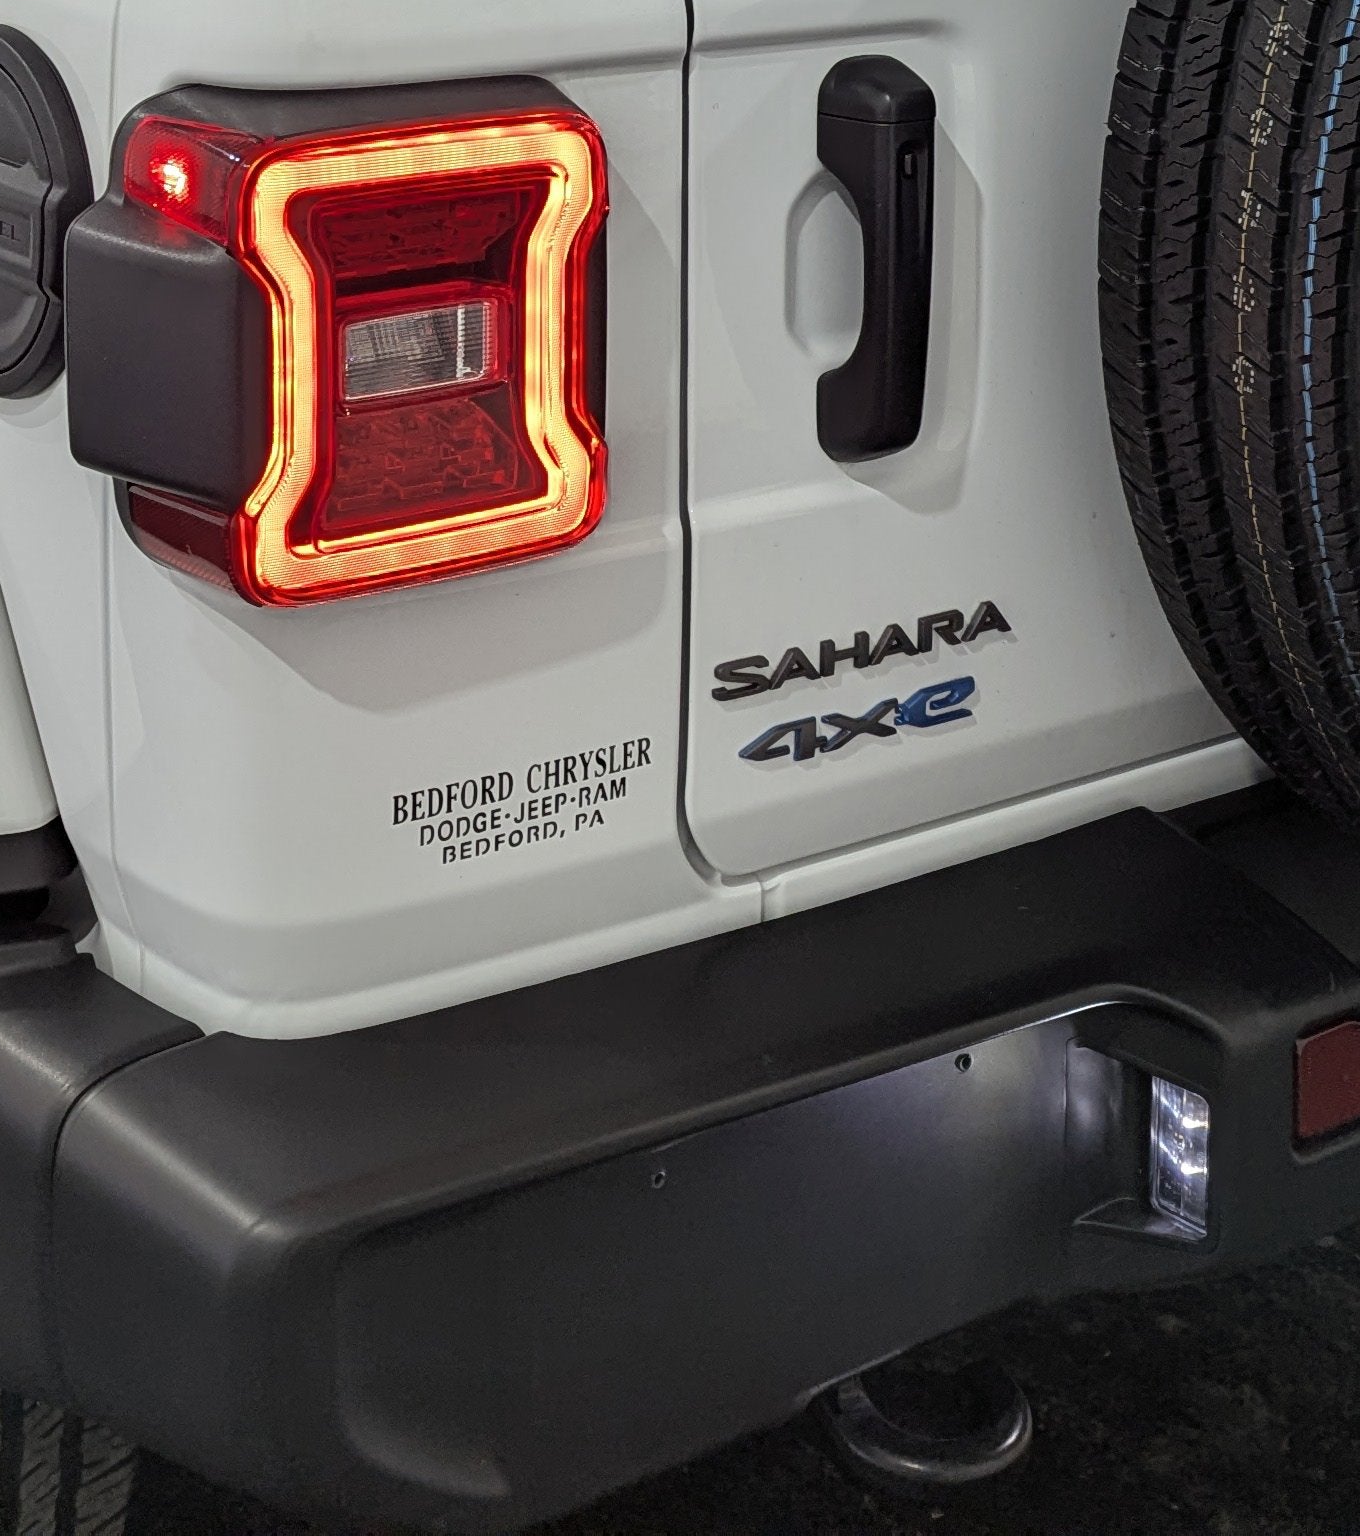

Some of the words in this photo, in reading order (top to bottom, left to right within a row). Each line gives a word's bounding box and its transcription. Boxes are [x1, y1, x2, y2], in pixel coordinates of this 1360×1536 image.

[711, 600, 1012, 702] SAHARA
[391, 770, 514, 826] BEDFORD
[526, 736, 652, 794] CHRYSLER
[442, 822, 566, 865] BEDFORD,
[574, 808, 605, 831] PA
